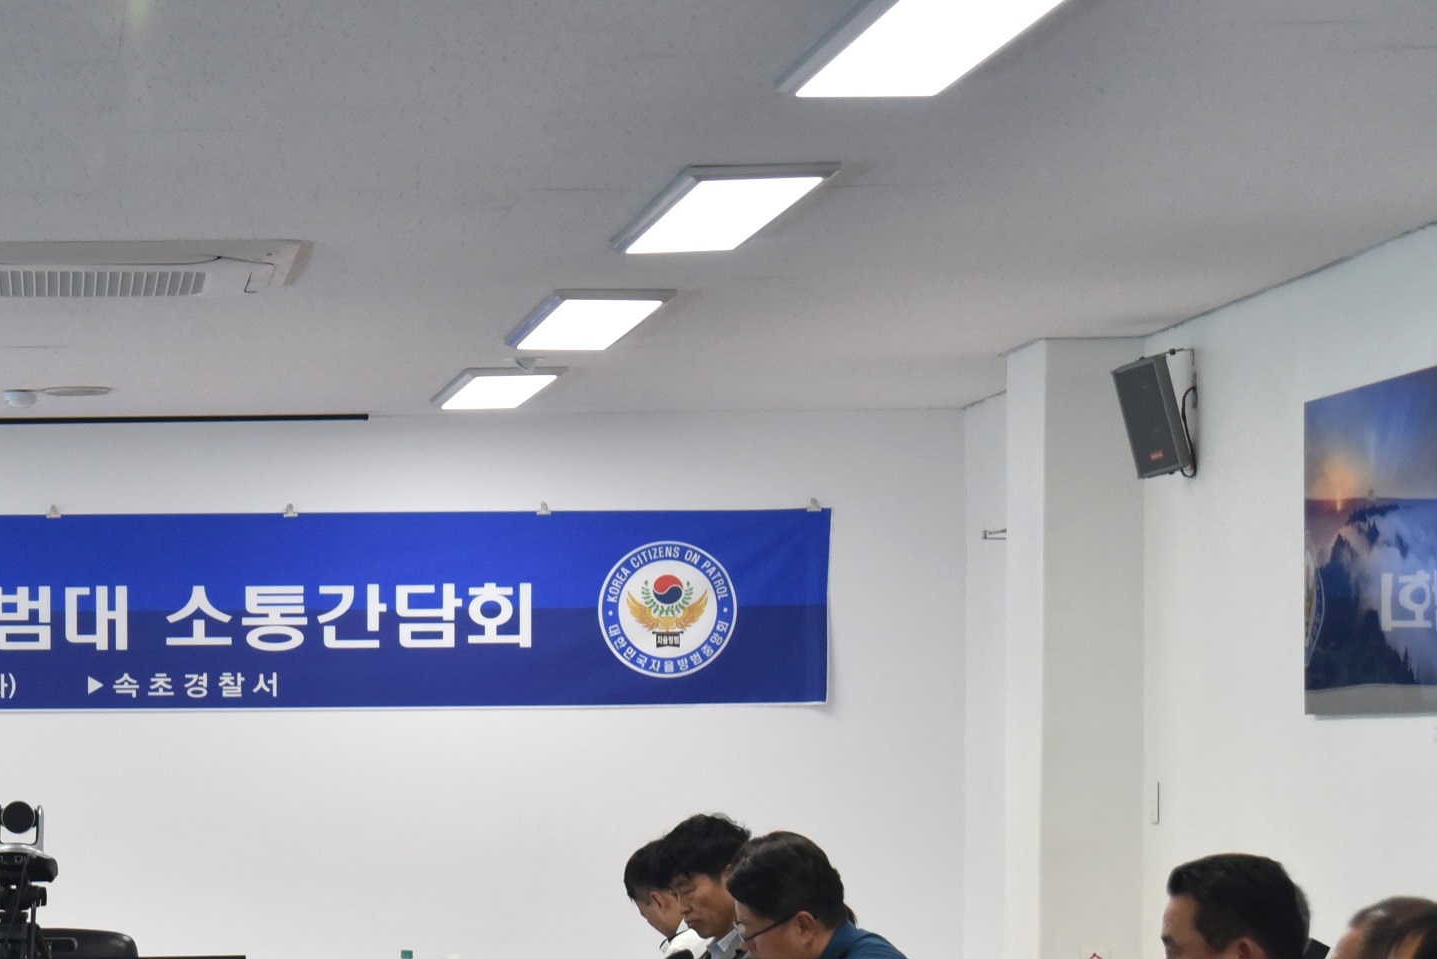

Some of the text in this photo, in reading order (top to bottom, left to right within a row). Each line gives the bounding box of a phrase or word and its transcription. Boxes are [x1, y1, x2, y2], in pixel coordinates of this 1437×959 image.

[607, 546, 729, 603] KOREA CITIZENS ON PATROL
[164, 582, 532, 652] 소통간담회
[112, 671, 278, 698] 속초경찰서
